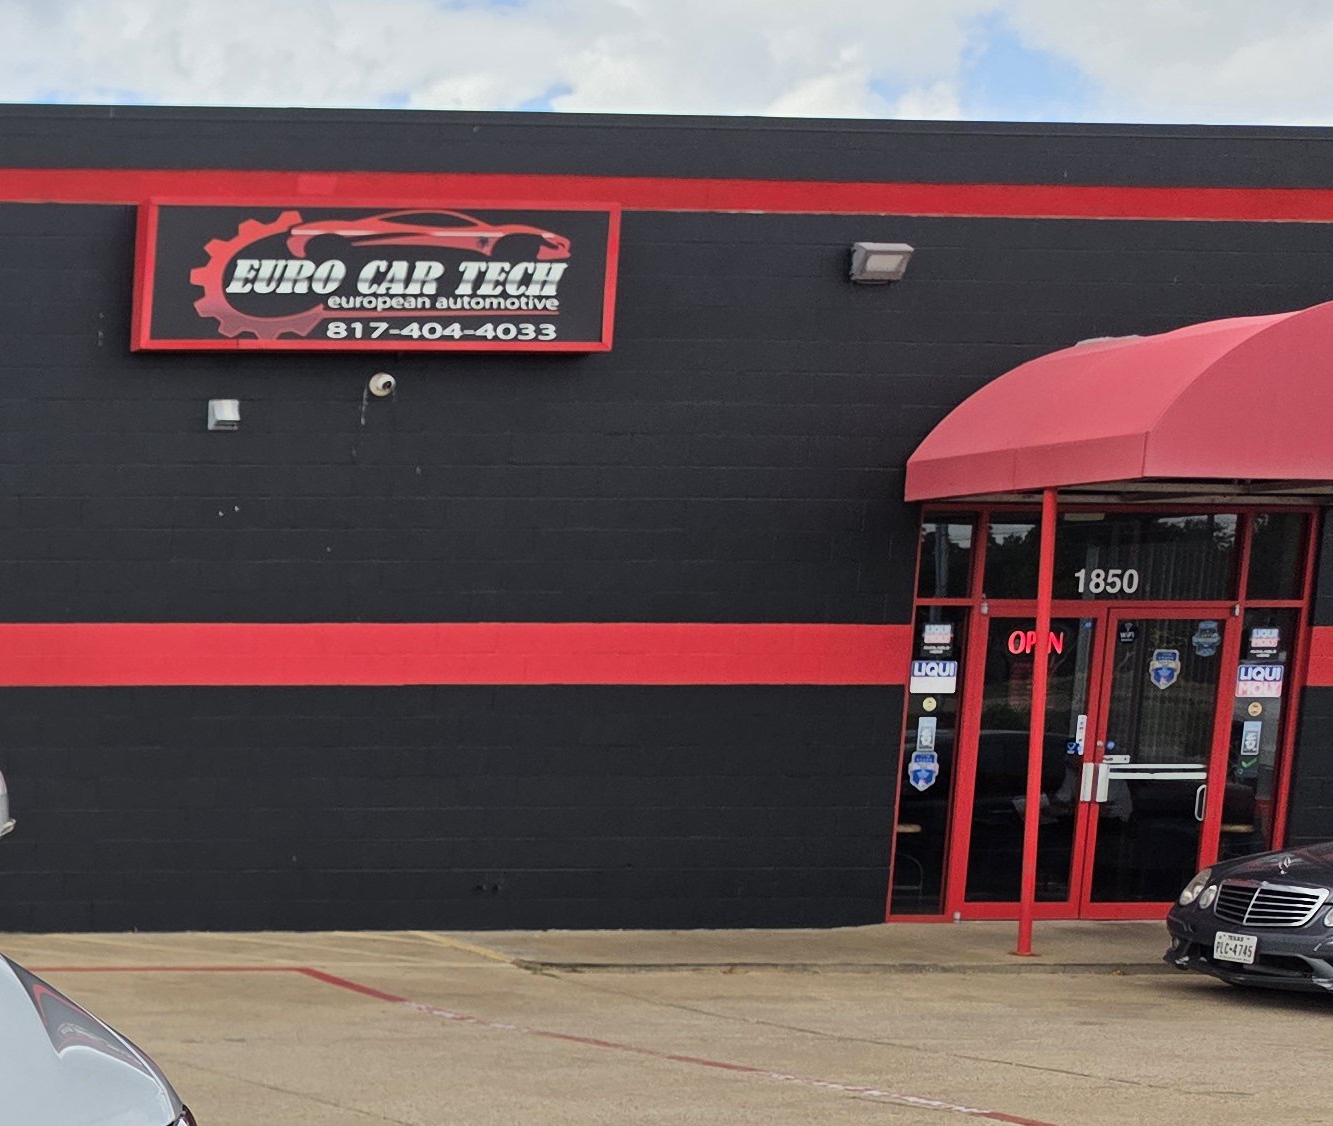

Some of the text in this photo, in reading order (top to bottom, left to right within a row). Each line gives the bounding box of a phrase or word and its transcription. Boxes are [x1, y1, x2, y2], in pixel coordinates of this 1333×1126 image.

[226, 259, 568, 296] EURO CAR TECH
[327, 295, 560, 312] european automotive
[326, 321, 557, 340] 817-404-4033
[1074, 568, 1139, 594] 1850
[1008, 630, 1064, 655] OPN
[914, 662, 955, 676] LIQUI
[1240, 667, 1282, 681] LIQUI
